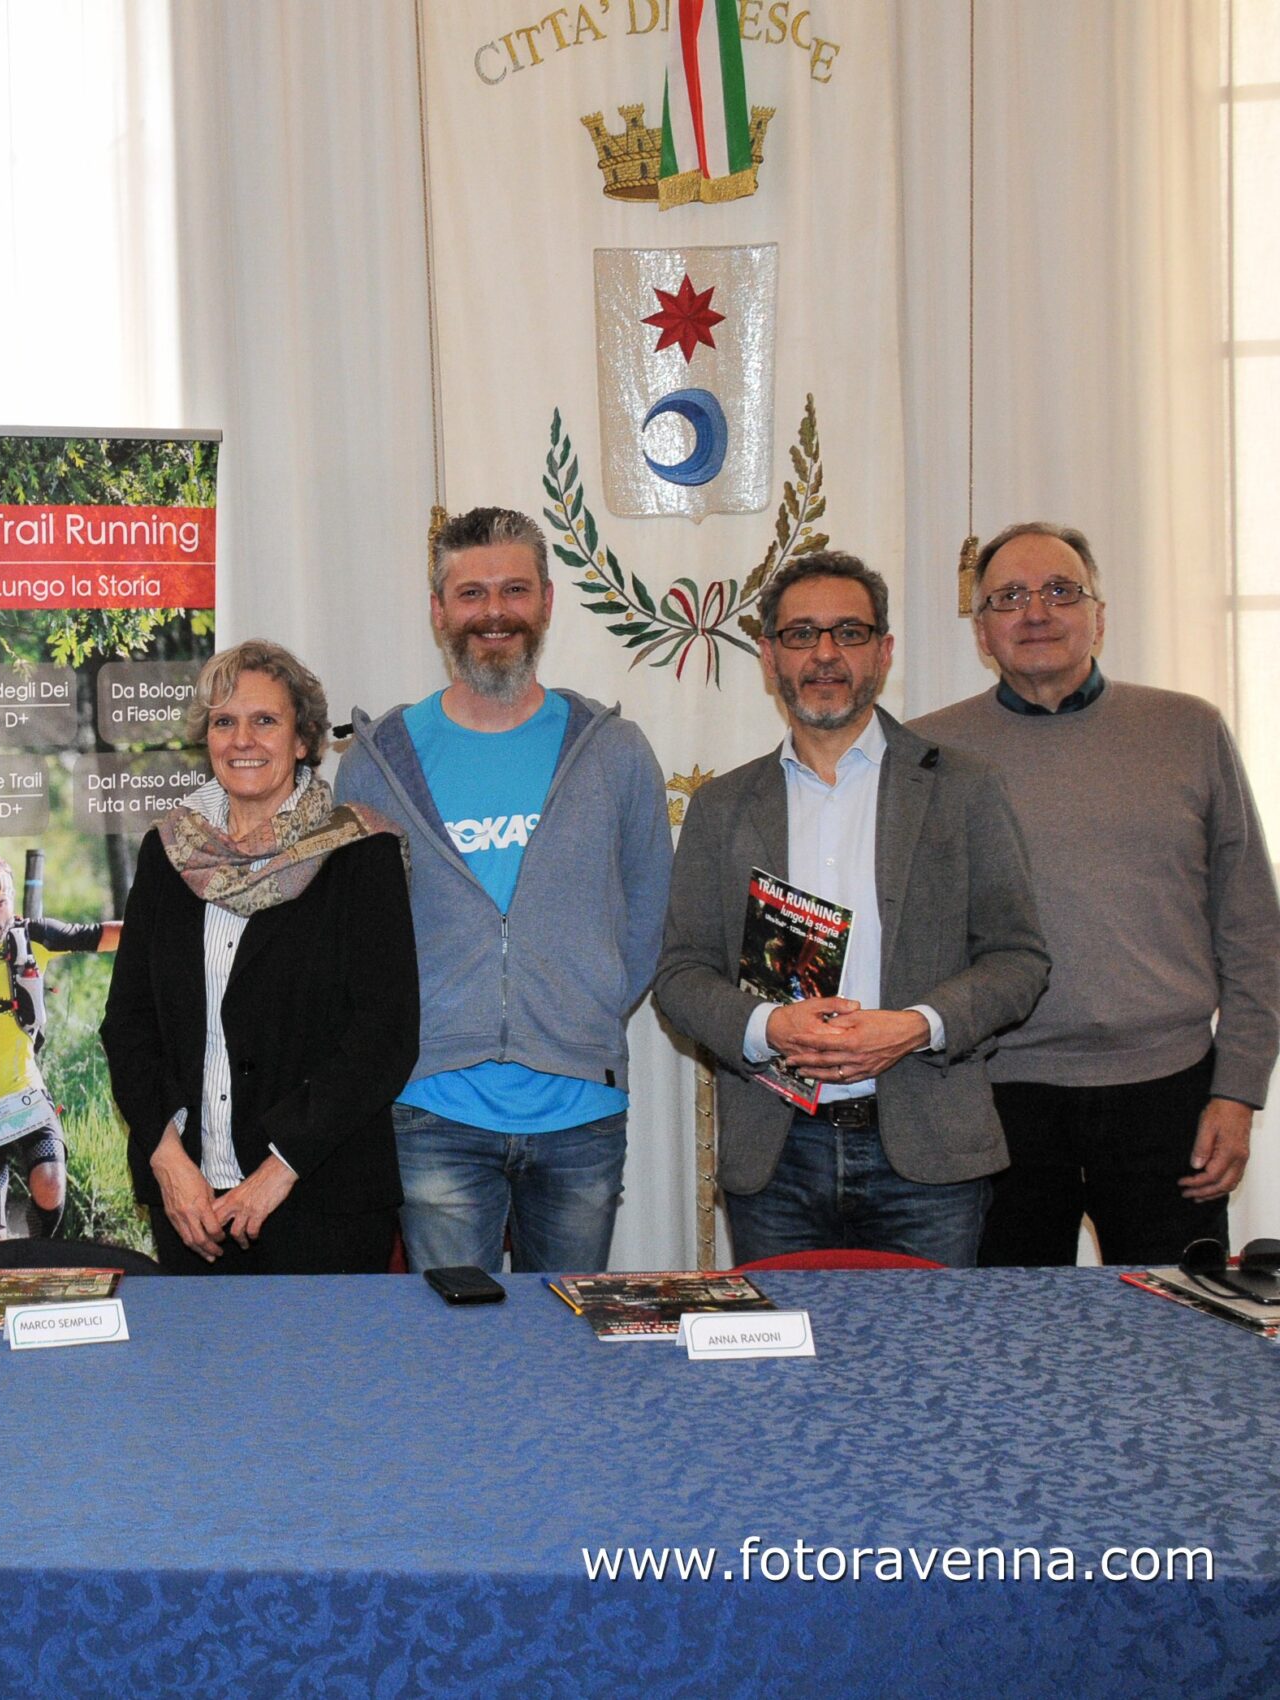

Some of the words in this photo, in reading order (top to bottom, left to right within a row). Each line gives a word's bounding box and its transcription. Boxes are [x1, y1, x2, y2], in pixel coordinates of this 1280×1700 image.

[474, 0, 610, 86] CITTA'
[66, 513, 199, 553] Running
[72, 575, 91, 597] la
[98, 575, 161, 597] Storia
[40, 681, 69, 698] Dei
[111, 683, 135, 699] Da
[139, 682, 198, 701] Bologn
[5, 711, 29, 728] D+
[112, 710, 123, 722] a
[127, 706, 181, 722] Fiesole
[9, 772, 42, 789] Trail
[88, 773, 116, 790] Dal
[120, 773, 165, 789] Passo
[169, 770, 206, 786] della
[88, 797, 124, 814] Futa
[129, 801, 140, 812] a
[145, 794, 187, 811] Fieso
[758, 878, 785, 902] TRAIL
[786, 892, 842, 925] RUNNING
[780, 905, 804, 924] lungo
[805, 915, 813, 927] la
[814, 921, 839, 938] storia
[20, 1319, 56, 1331] MARCO
[59, 1316, 103, 1328] SEMPLICI
[709, 1335, 737, 1346] ANNA
[740, 1331, 782, 1344] RAVONI
